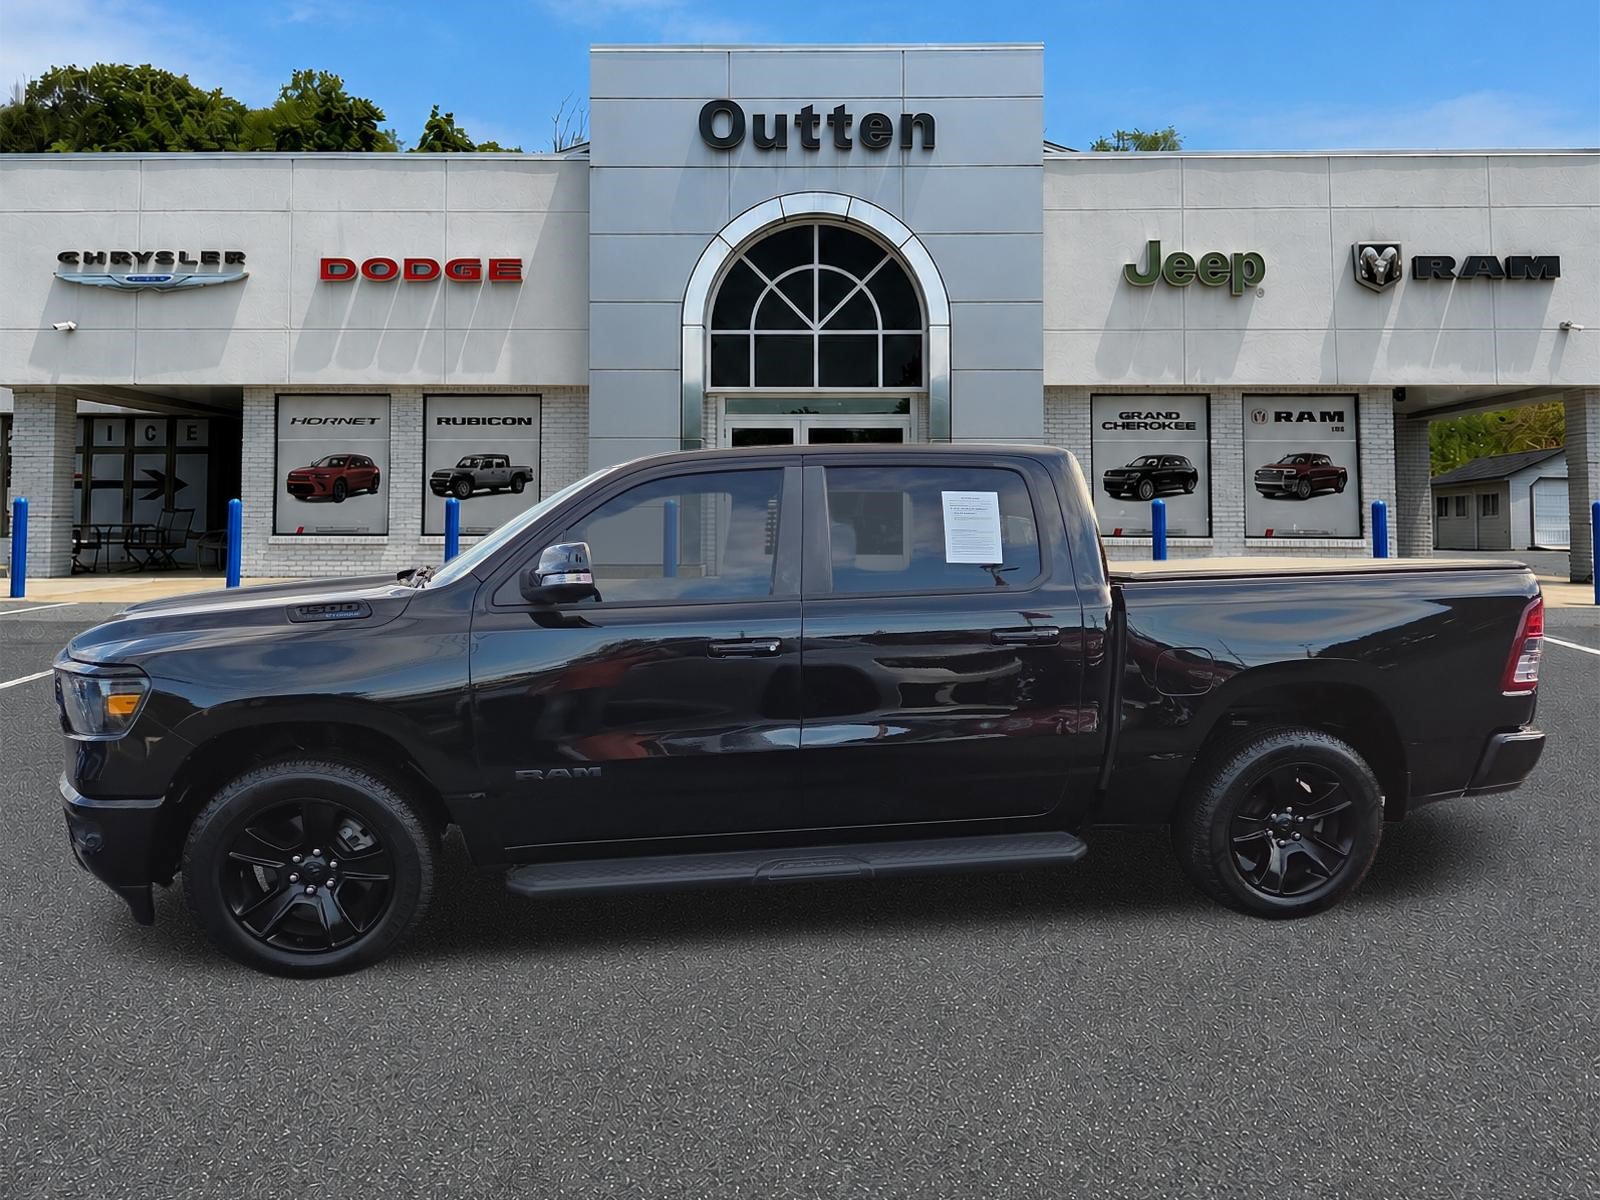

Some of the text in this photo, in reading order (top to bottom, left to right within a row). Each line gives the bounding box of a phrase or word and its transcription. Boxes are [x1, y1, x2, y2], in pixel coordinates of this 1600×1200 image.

[699, 99, 936, 150] Outten
[57, 251, 247, 265] CHRYSLER
[320, 257, 523, 282] DODGE
[1123, 239, 1266, 297] Jeep
[1411, 255, 1561, 280] RAM
[290, 417, 381, 426] HORNET
[436, 417, 533, 426] RUBICON
[1118, 411, 1181, 420] GRAND
[1274, 411, 1345, 423] RAM
[1101, 421, 1197, 431] CHEROKEE
[514, 766, 602, 780] RAM
